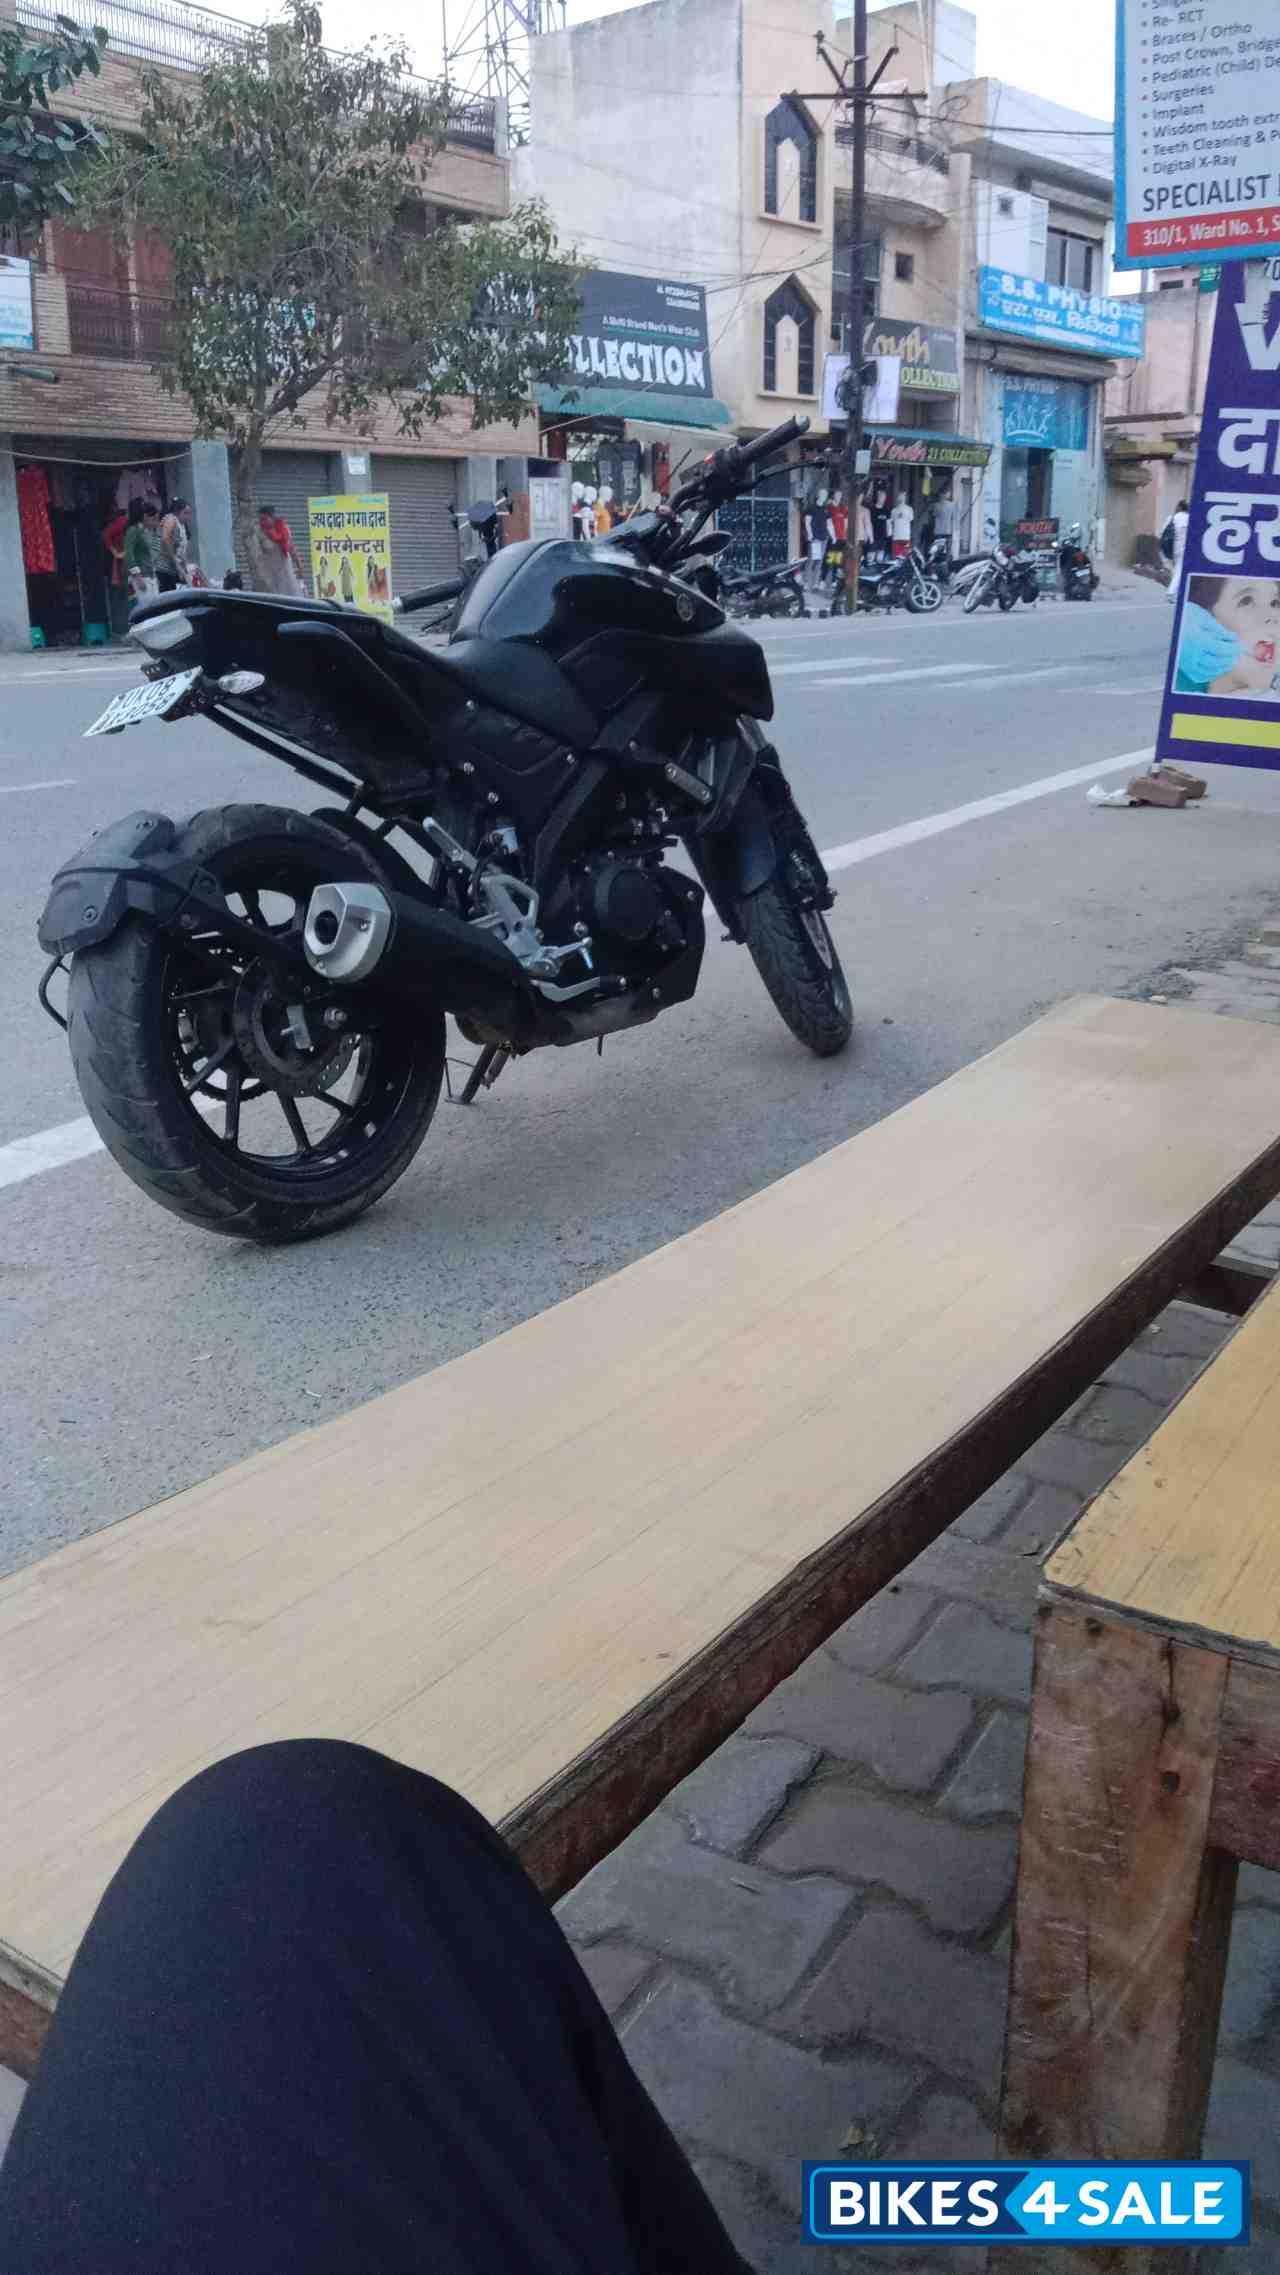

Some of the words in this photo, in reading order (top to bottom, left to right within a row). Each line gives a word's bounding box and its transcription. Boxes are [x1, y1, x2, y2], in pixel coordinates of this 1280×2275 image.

[1178, 8, 1205, 24] RCT
[1152, 31, 1196, 47] Braces
[1210, 22, 1253, 39] Ortho
[1152, 50, 1180, 65] Post
[1152, 65, 1212, 84] Pediatric
[1216, 57, 1261, 79] (Child)
[1152, 83, 1215, 103] Surgeries
[1152, 103, 1205, 121] Implant
[1152, 122, 1208, 139] Wisdom
[1212, 114, 1249, 131] tooth
[1152, 140, 1189, 156] Teeth
[1193, 133, 1251, 152] Cleaning
[1255, 130, 1265, 144] &
[1152, 156, 1196, 176] Digital
[1198, 154, 1237, 168] X-Ray
[1143, 173, 1271, 213] SPECIALIST
[1143, 224, 1187, 247] 310/1,
[1190, 219, 1226, 241] Ward
[1229, 217, 1253, 237] No.
[1256, 216, 1269, 237] 1,
[1047, 285, 1122, 321] PHYSIO
